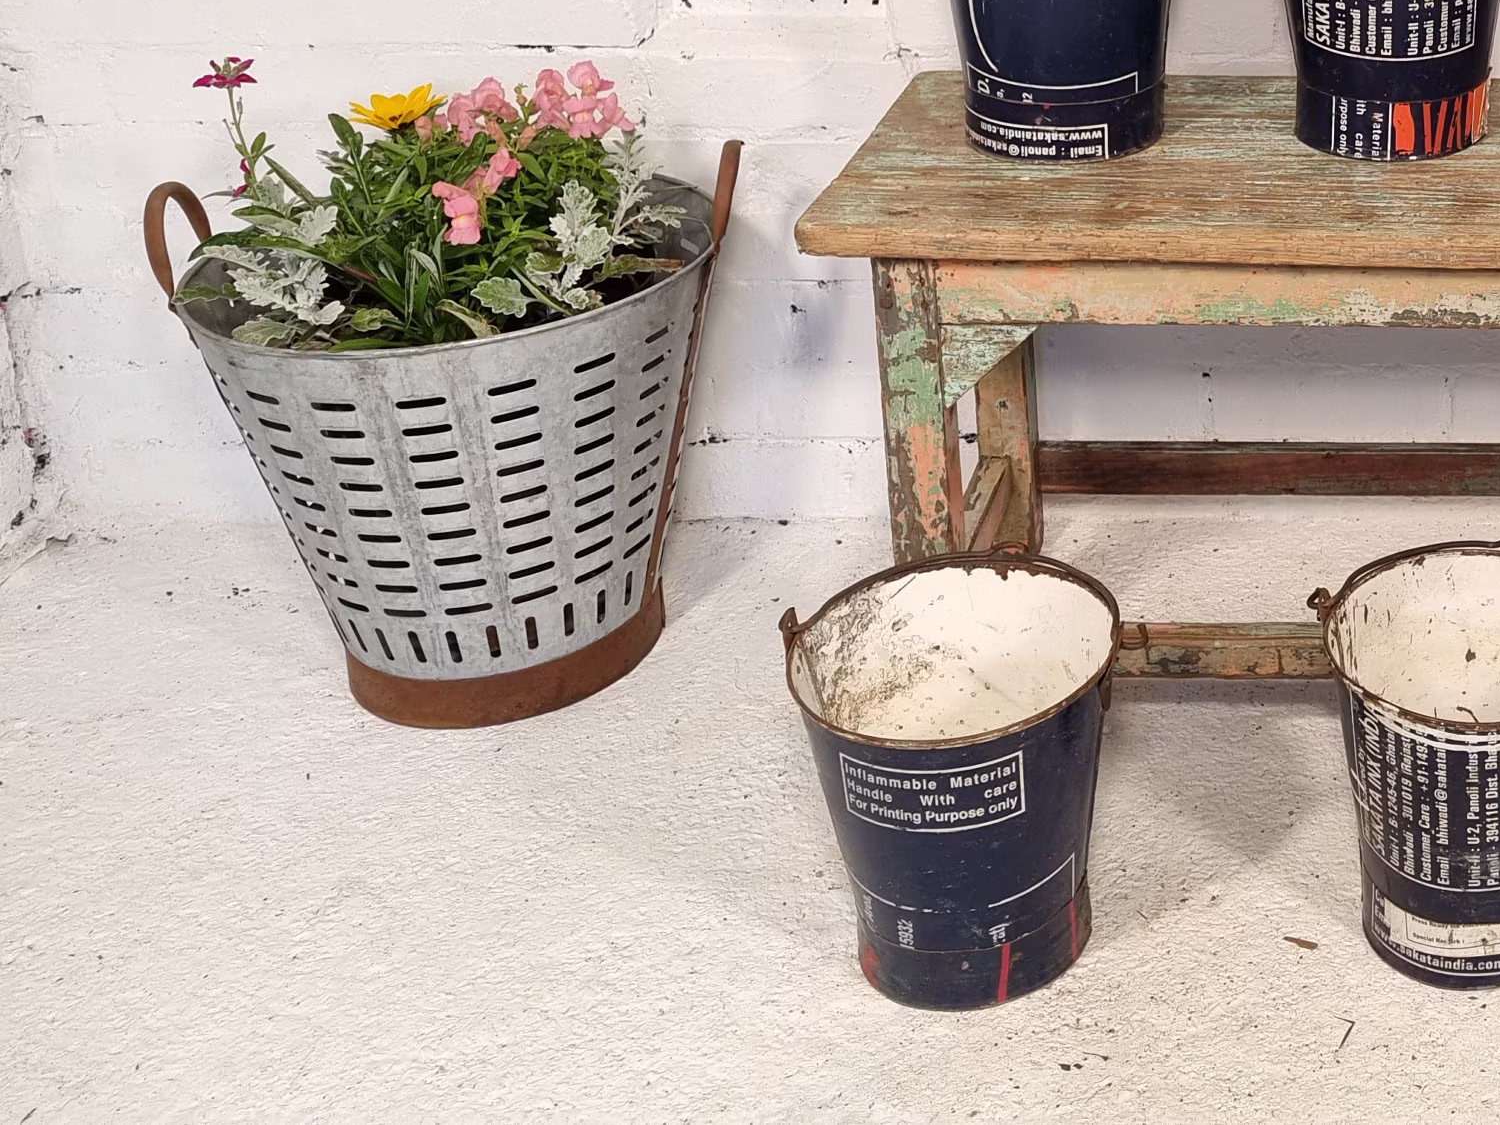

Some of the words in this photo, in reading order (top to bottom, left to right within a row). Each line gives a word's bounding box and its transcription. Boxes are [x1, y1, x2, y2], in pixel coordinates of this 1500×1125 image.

[1349, 9, 1361, 53] Bhiwadi
[1365, 5, 1377, 55] Customer
[1381, 26, 1393, 56] Email
[1423, 20, 1434, 54] Panoli
[1438, 1, 1449, 51] Customer
[1451, 18, 1462, 49] Email
[1070, 145, 1103, 158] Email
[845, 762, 937, 790] Inflammable
[950, 762, 1016, 789] Material
[1366, 754, 1382, 791] INX
[847, 779, 893, 803] Handle
[919, 794, 955, 807] With
[984, 781, 1018, 799] care
[849, 793, 868, 810] For
[870, 803, 921, 824] Printing
[926, 807, 985, 823] Purpose
[988, 796, 1018, 814] only
[1401, 778, 1413, 821] 301019
[1466, 786, 1480, 820] Panoli
[1369, 788, 1386, 857] SAKATA
[1418, 804, 1431, 829] Care
[1485, 803, 1499, 843] 394116
[1466, 824, 1482, 845] U-2,
[1420, 832, 1432, 882] Customer
[1437, 856, 1450, 885] Email
